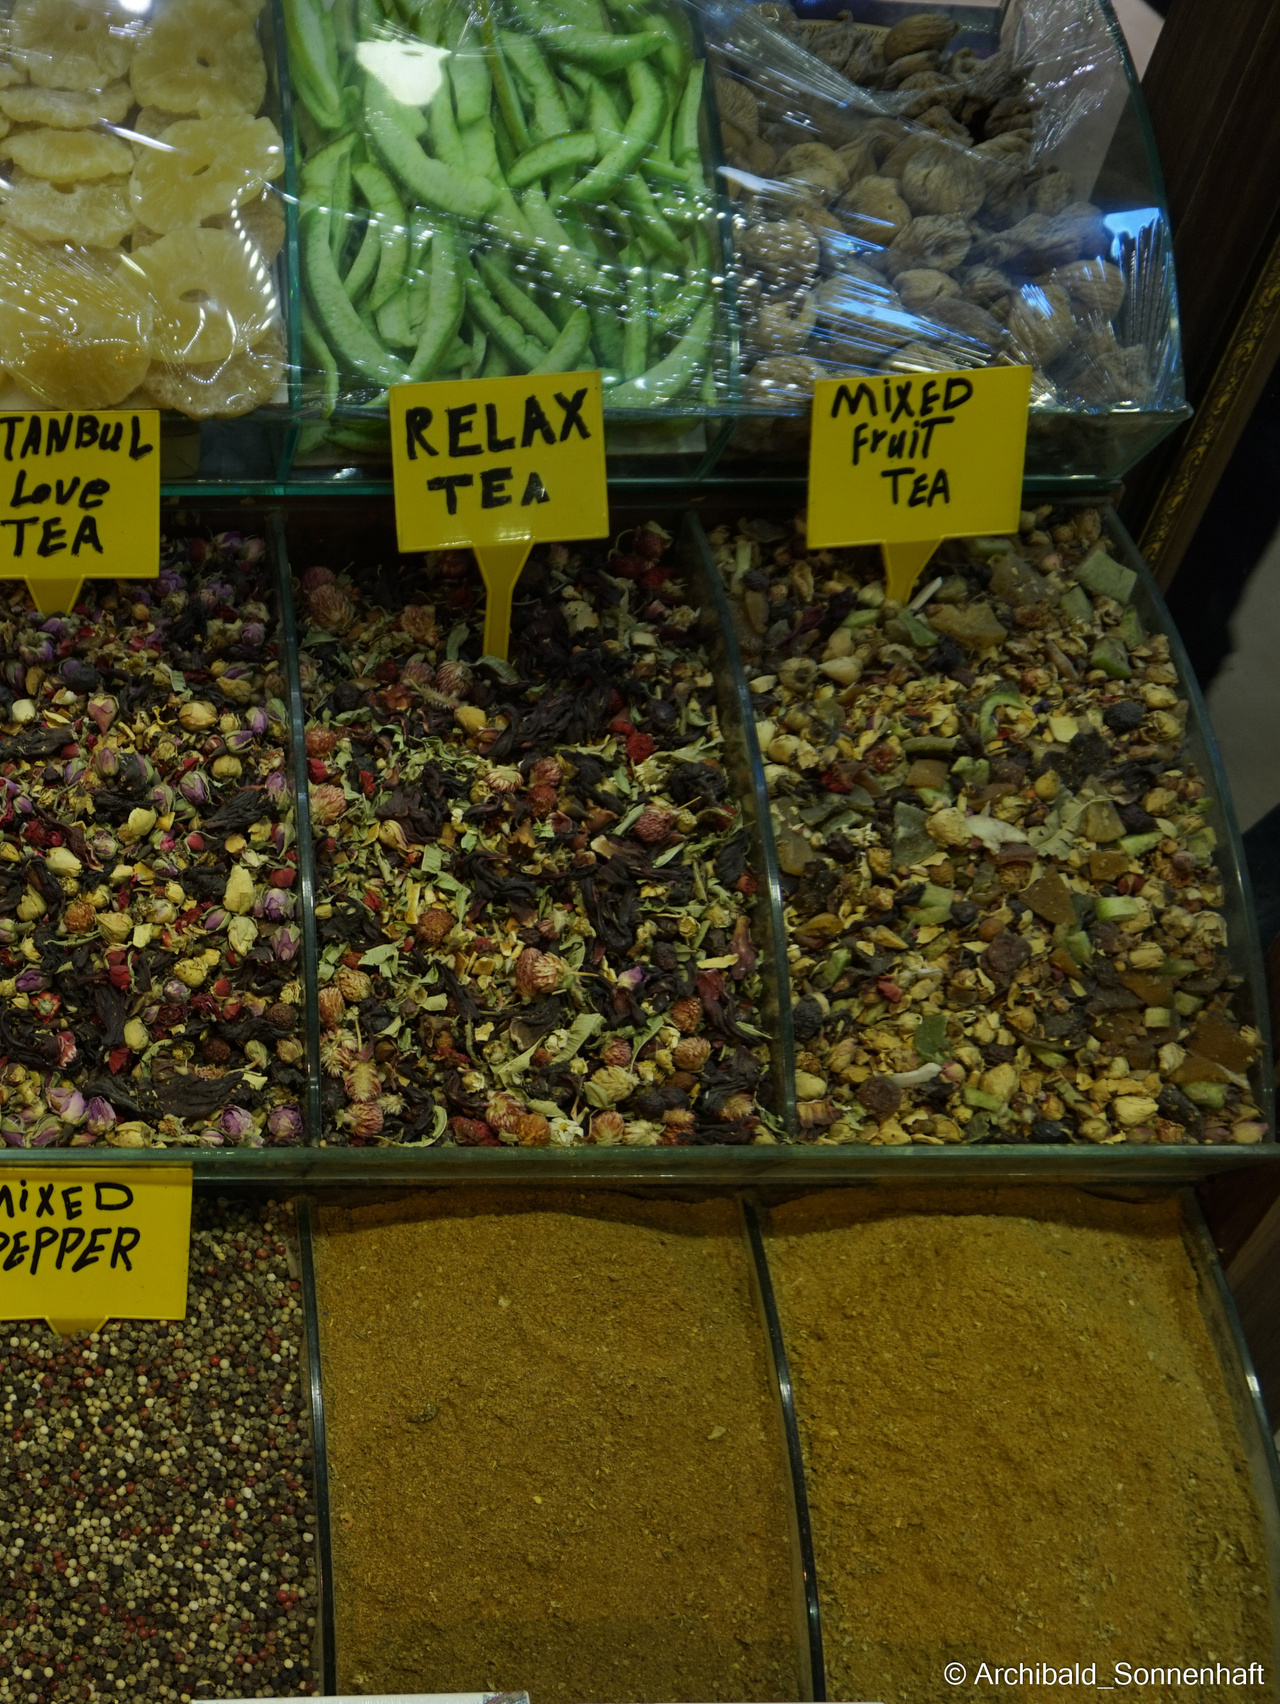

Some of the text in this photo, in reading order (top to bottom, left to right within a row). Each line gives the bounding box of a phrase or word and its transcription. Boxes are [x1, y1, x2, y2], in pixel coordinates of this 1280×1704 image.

[406, 387, 592, 460] RELAX
[427, 466, 551, 515] TEA
[881, 467, 951, 507] TEA
[0, 514, 104, 557] TEA
